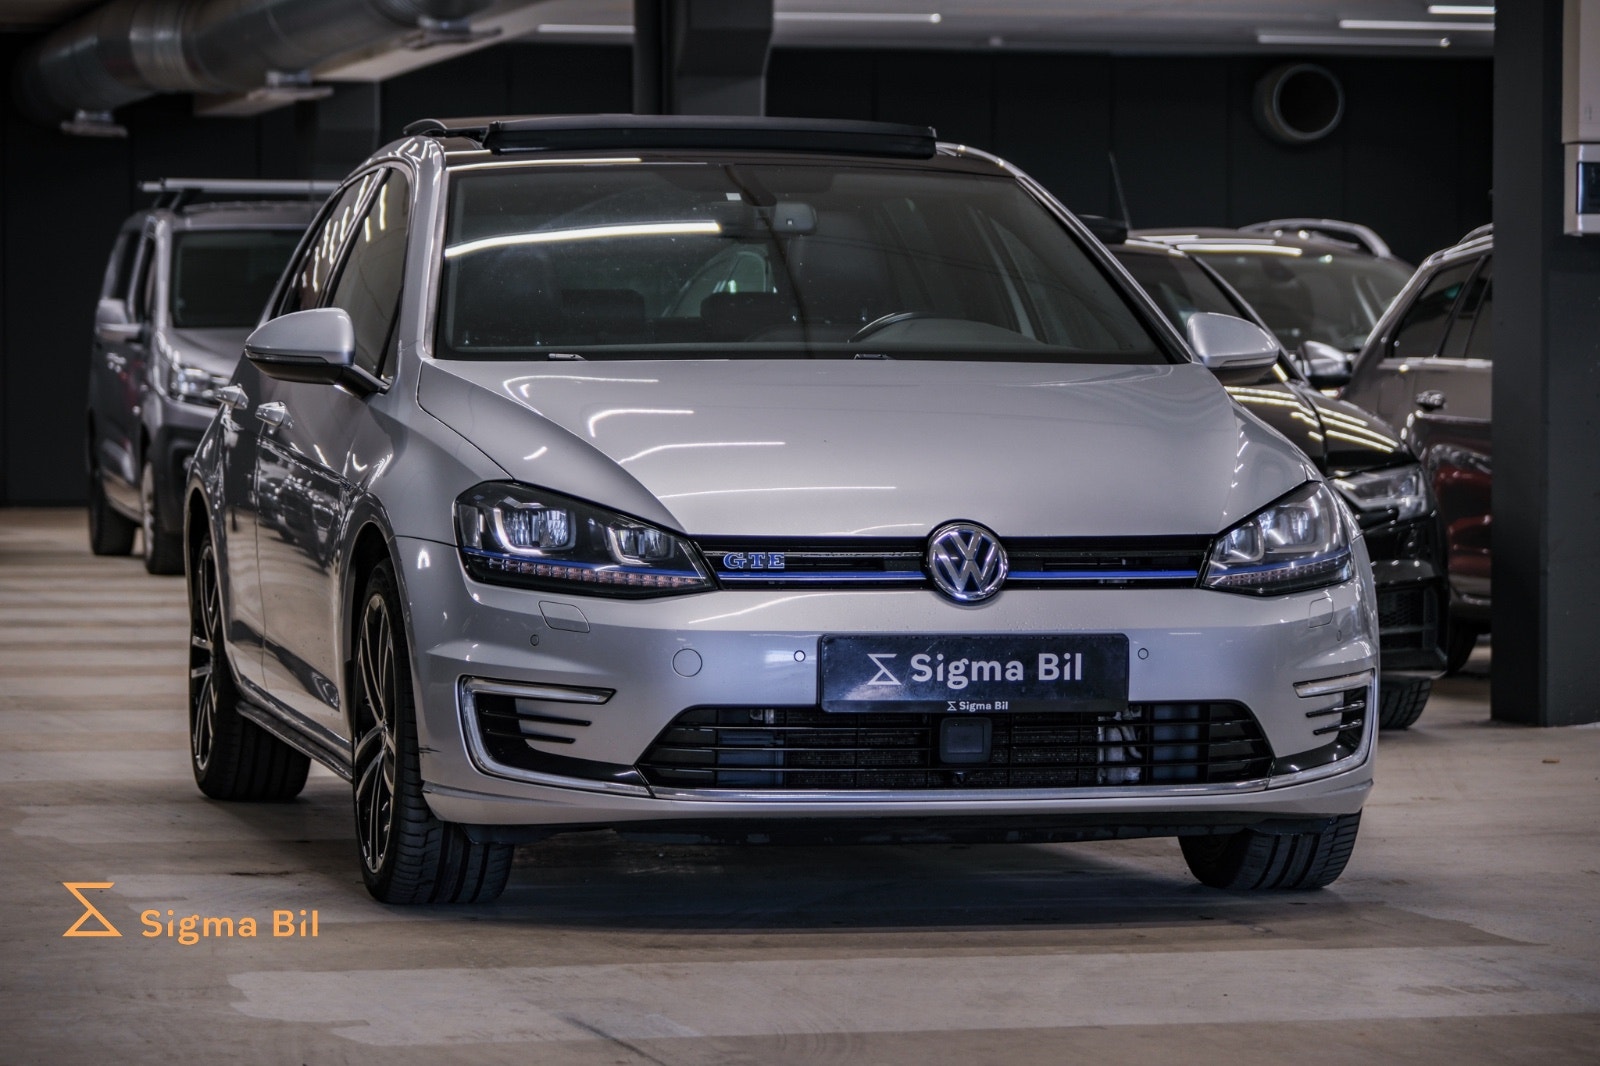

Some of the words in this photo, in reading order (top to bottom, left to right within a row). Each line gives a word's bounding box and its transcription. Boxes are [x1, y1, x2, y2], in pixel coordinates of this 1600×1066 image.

[723, 552, 785, 569] GTE
[910, 653, 1024, 690] Sigma
[1038, 653, 1083, 681] Bil
[959, 701, 992, 712] Sigma
[994, 701, 1009, 710] Bil
